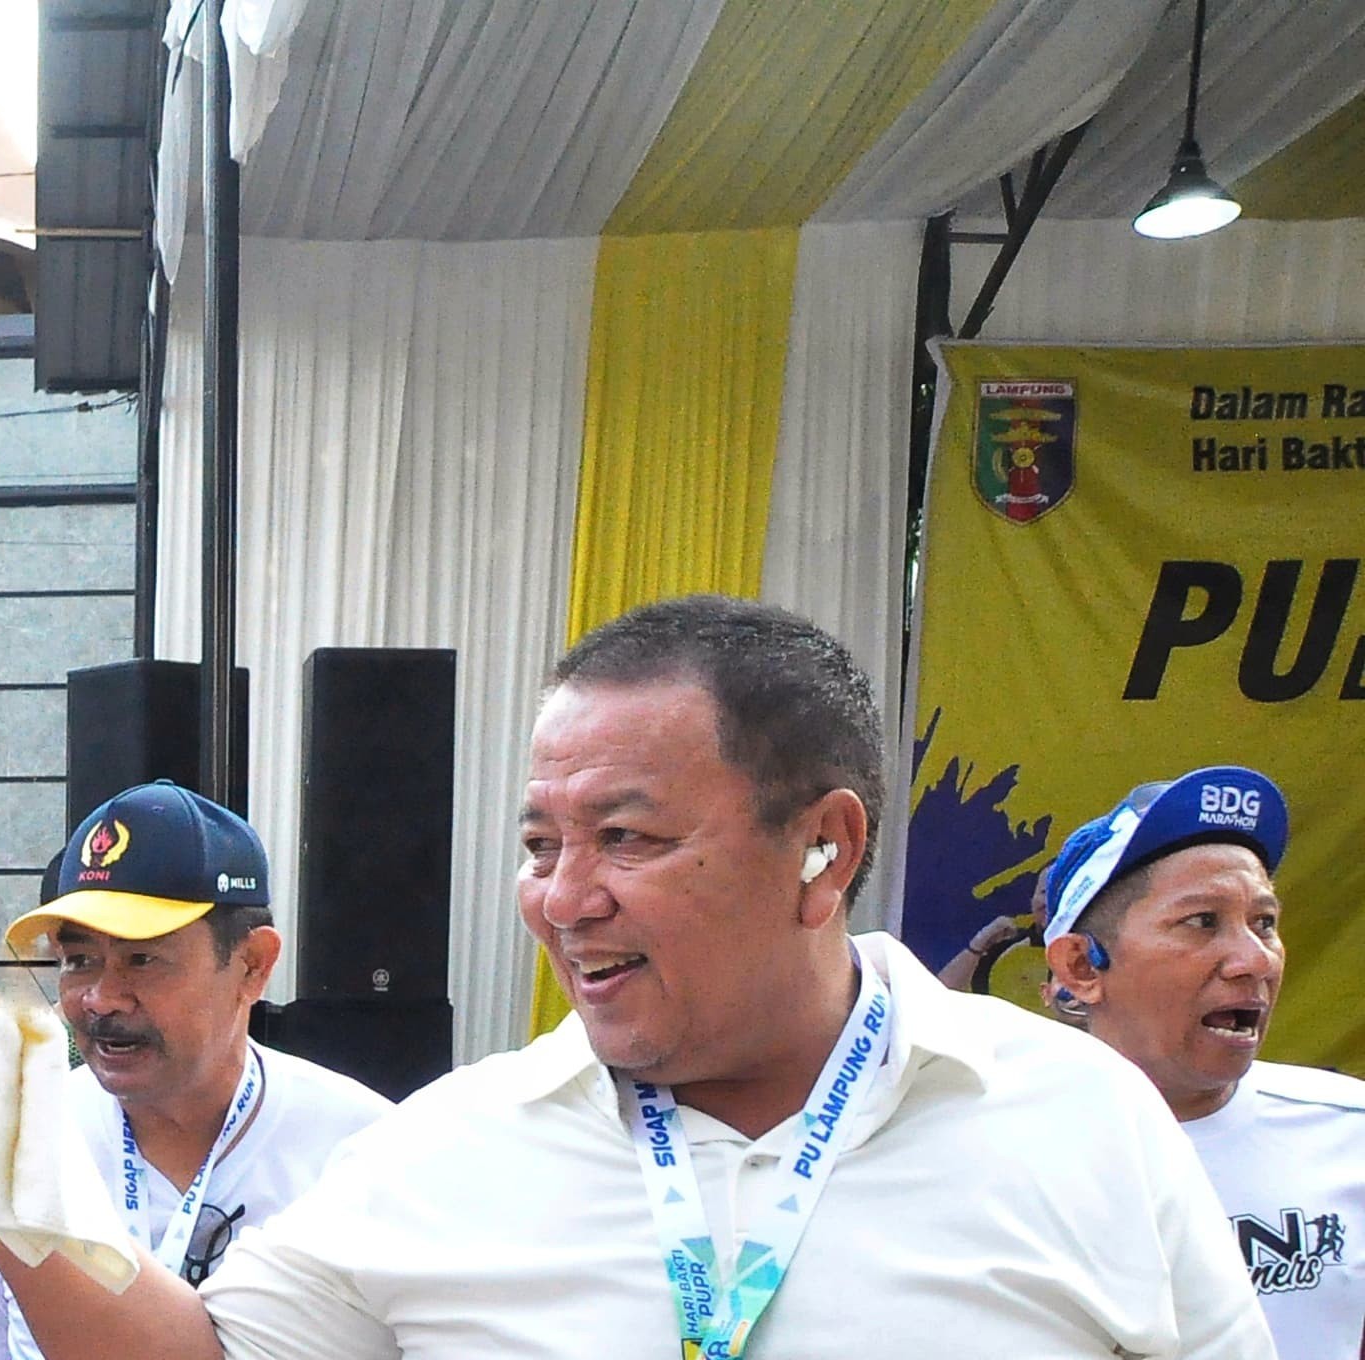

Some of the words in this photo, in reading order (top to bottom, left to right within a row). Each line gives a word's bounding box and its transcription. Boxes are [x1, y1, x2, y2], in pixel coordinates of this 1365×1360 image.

[985, 384, 1066, 395] LAMPUNG
[1190, 386, 1307, 420] Dalam
[1321, 384, 1365, 418] Ra
[1192, 437, 1267, 472] Hari
[1282, 437, 1365, 472] Bakt
[1201, 784, 1261, 816] BDG
[1199, 812, 1258, 829] MARATHON
[78, 870, 111, 882] KONI
[230, 877, 257, 890] MILLS
[236, 1079, 255, 1114] RUN
[793, 1143, 822, 1179] PU
[810, 1035, 872, 1144] LAMPUNG
[641, 1104, 677, 1168] SIGAP
[123, 1159, 139, 1211] SIGAP
[182, 1191, 197, 1215] PU
[671, 1249, 692, 1291] BAKTI
[1250, 1253, 1319, 1289] ners
[690, 1262, 714, 1317] PUPR
[684, 1296, 699, 1334] HARI
